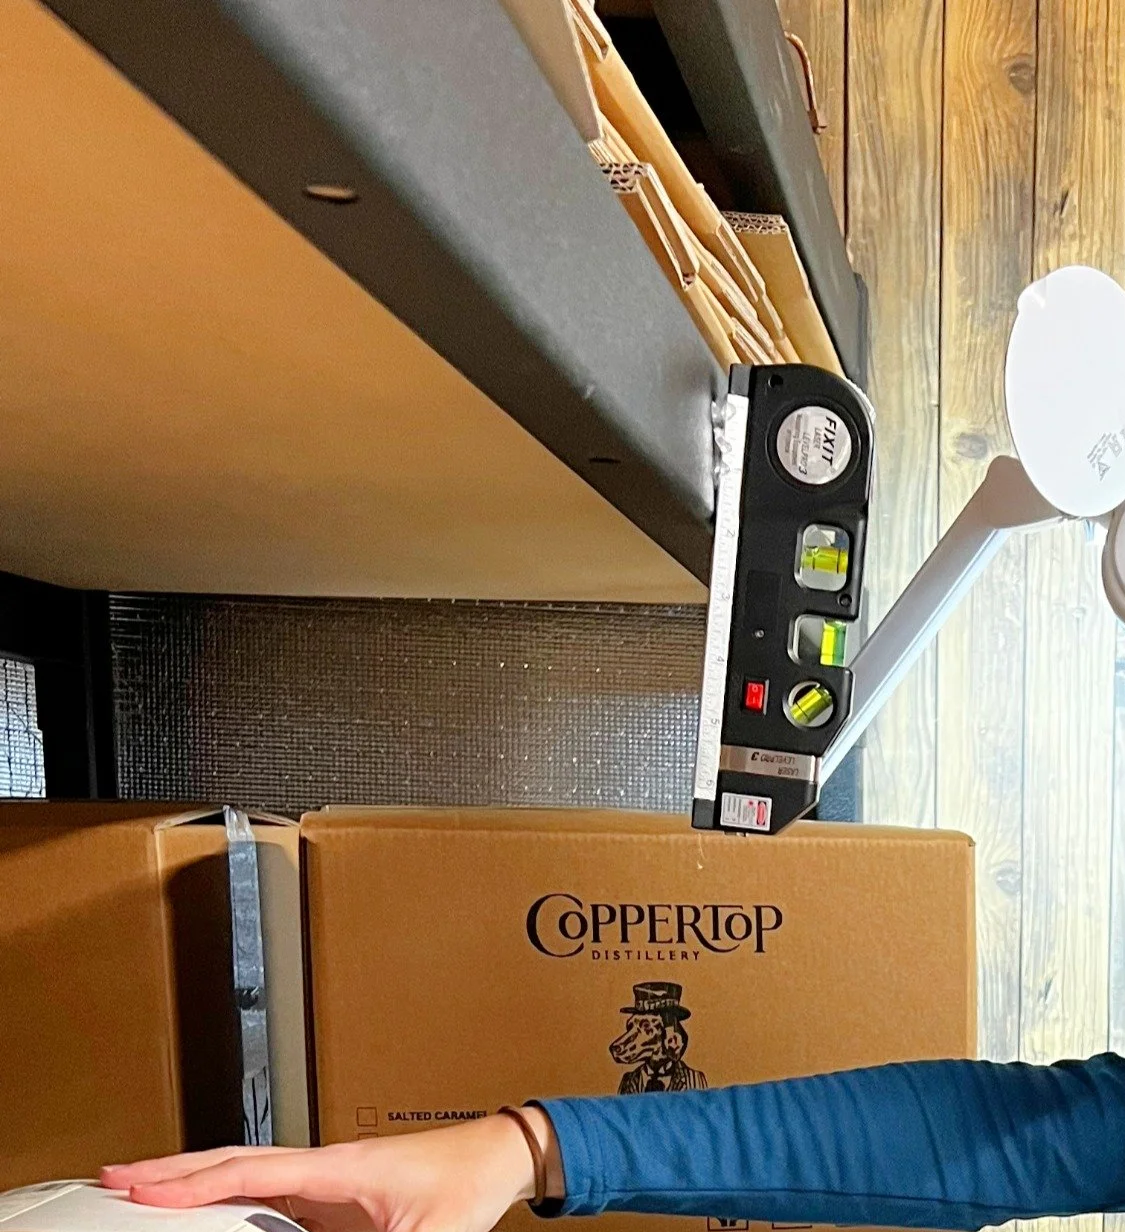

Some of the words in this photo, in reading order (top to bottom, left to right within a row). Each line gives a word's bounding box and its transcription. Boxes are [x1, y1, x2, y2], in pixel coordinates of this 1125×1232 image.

[821, 415, 837, 467] FIXIT
[526, 893, 784, 958] COPPERTOP
[591, 949, 701, 961] DISTILLERY
[387, 1111, 432, 1121] SALTED
